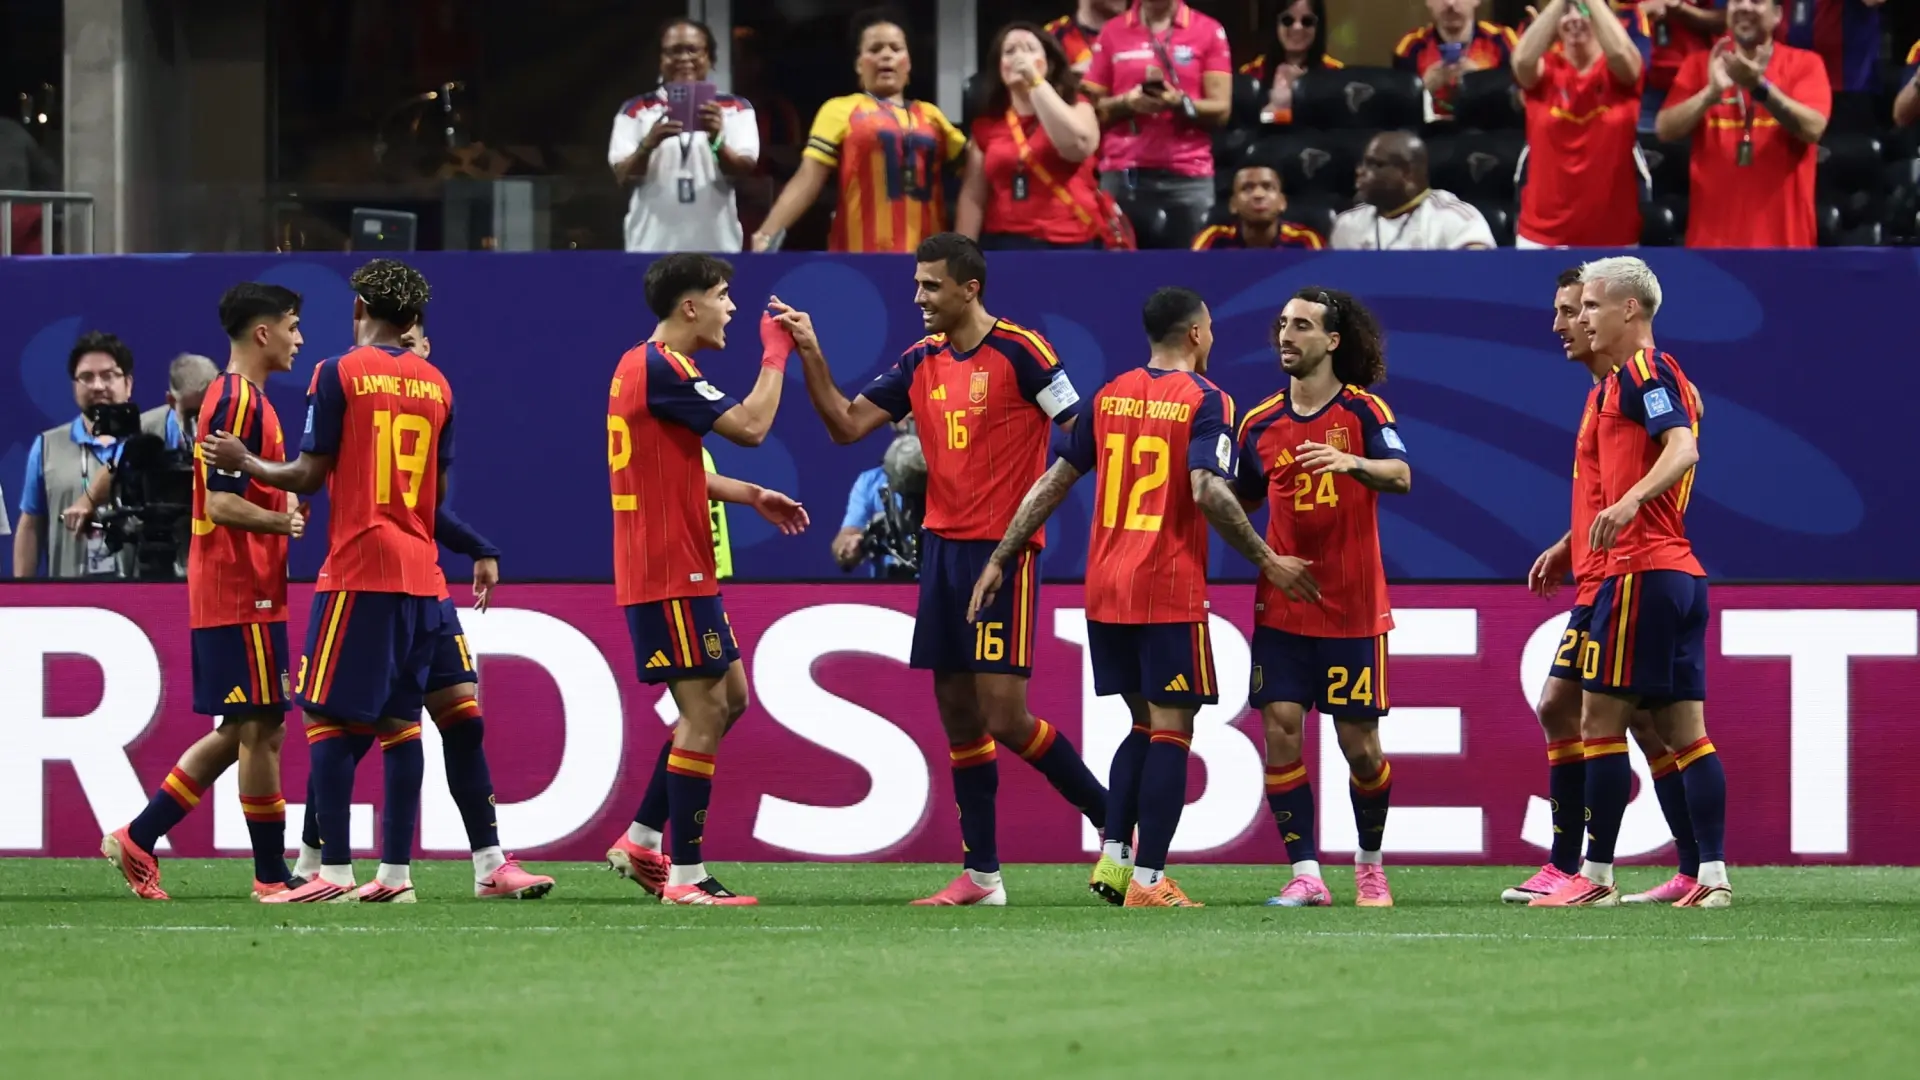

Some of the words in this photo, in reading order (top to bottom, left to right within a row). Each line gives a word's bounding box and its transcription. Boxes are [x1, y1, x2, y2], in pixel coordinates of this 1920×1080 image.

[352, 374, 402, 396] LAMINE
[1101, 396, 1144, 419] PEDRO
[944, 410, 968, 450] 16
[373, 410, 431, 509] 19
[1103, 433, 1170, 531] 12
[1294, 471, 1339, 512] 24
[975, 621, 1004, 660] 16
[1554, 628, 1590, 668] 21
[1327, 666, 1373, 706] 24
[0, 604, 929, 856] RDS
[1054, 606, 1919, 858] BEST
